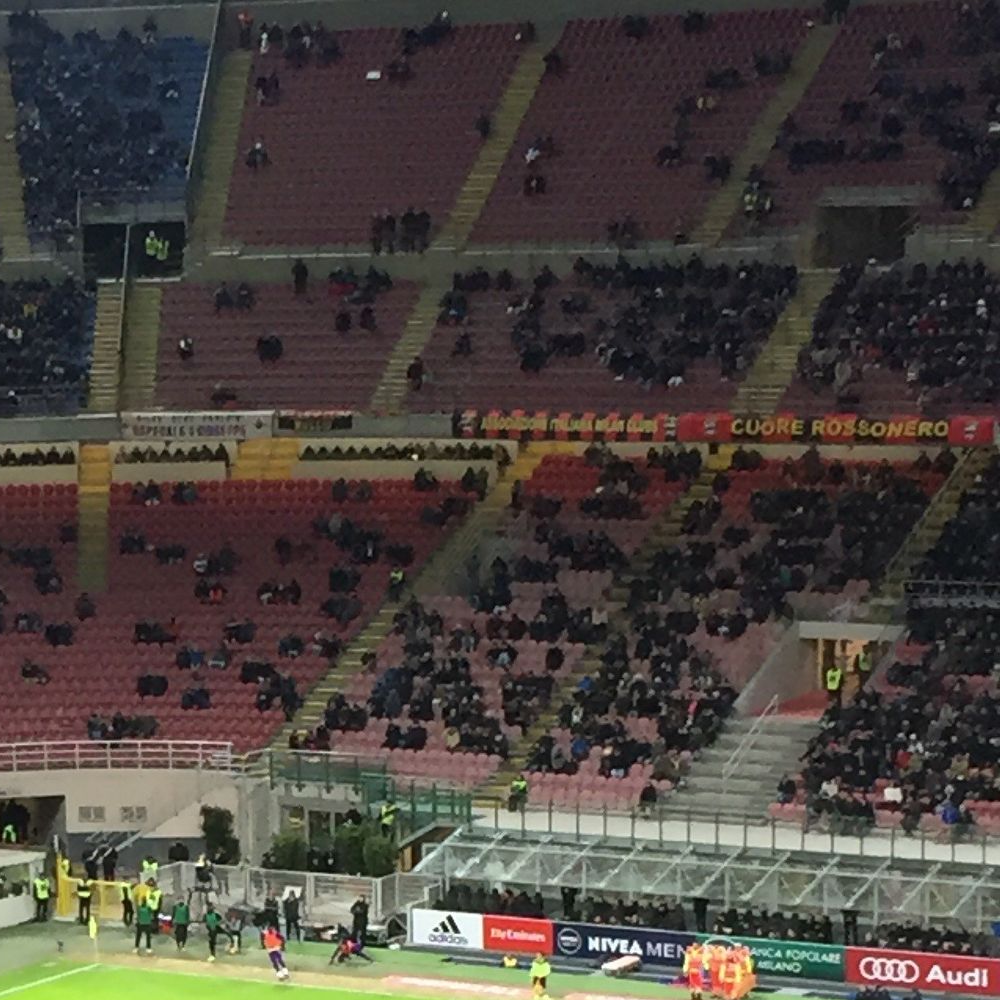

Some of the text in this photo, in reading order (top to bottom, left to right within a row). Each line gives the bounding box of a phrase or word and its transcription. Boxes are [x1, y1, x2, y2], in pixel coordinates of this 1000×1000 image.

[731, 417, 949, 437] CUORE ROSSONERO
[428, 933, 469, 945] adidas
[490, 927, 546, 943] Fly Emirates
[588, 936, 686, 959] NIVEA MEN
[751, 946, 842, 964] ANCA POPOLARE
[758, 961, 802, 973] MILANO
[926, 964, 988, 988] Audi
